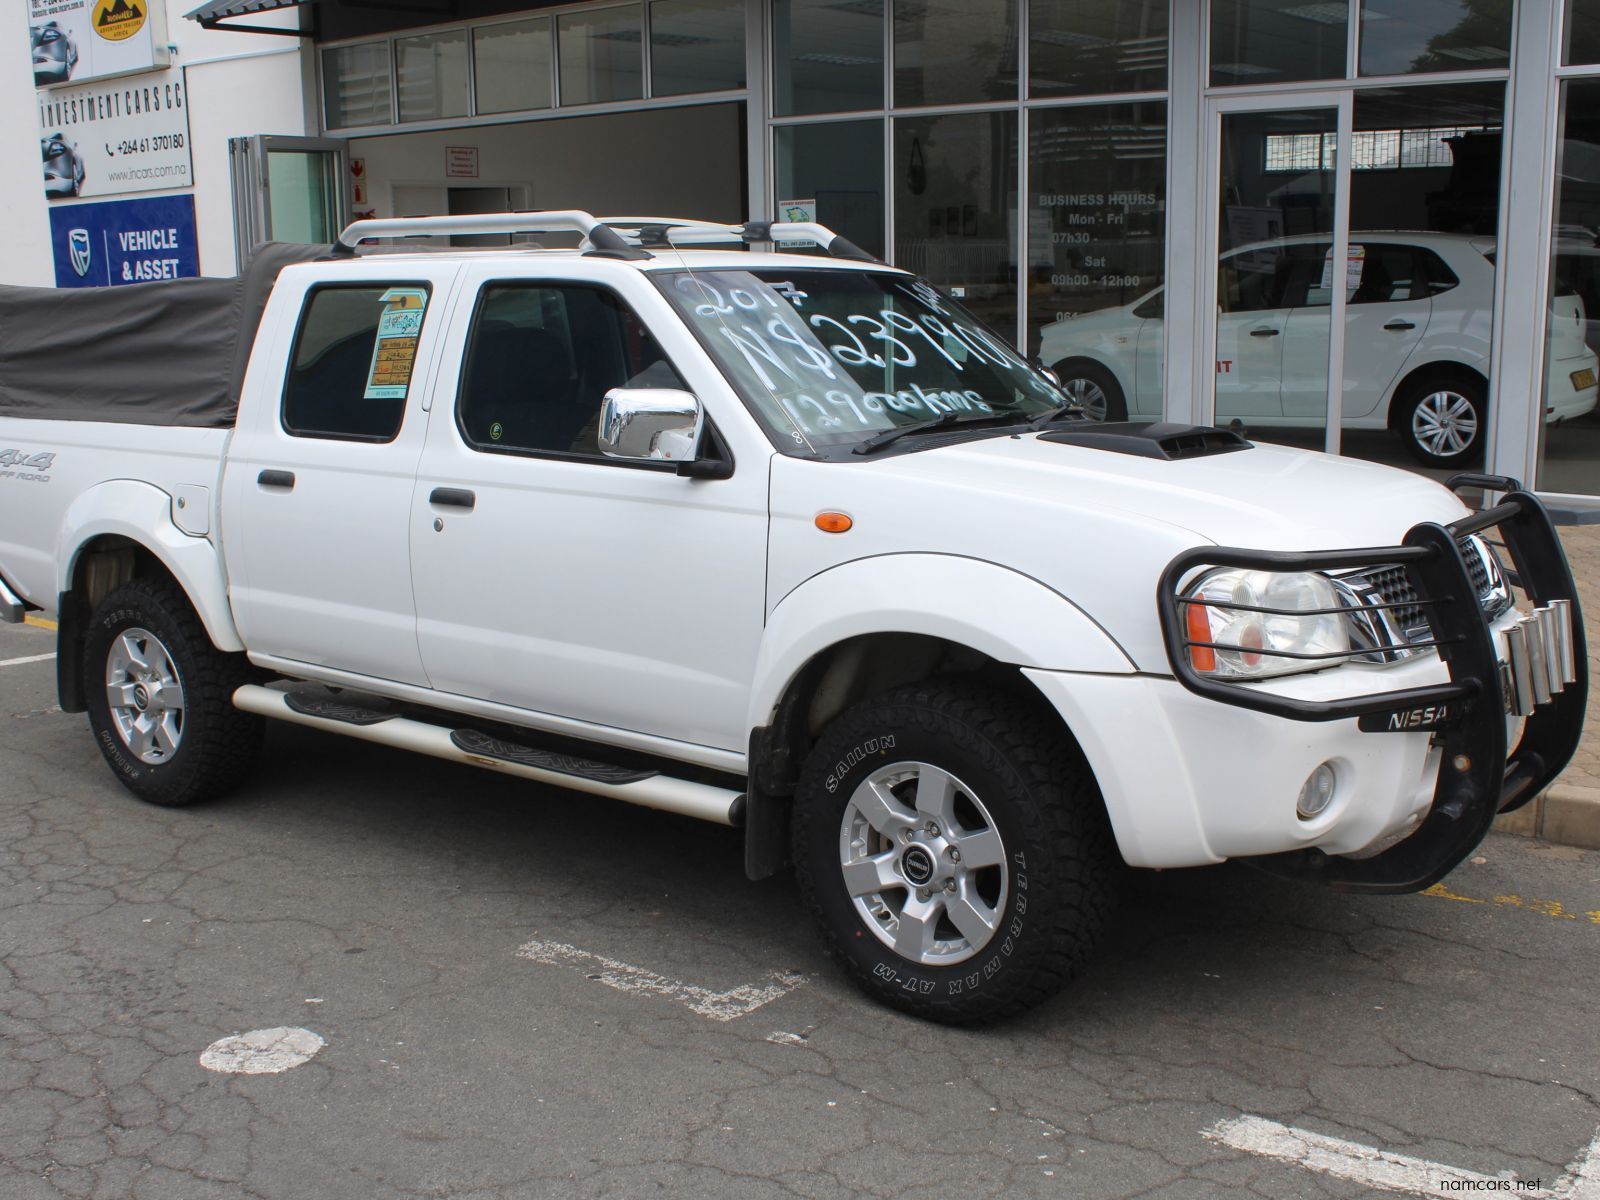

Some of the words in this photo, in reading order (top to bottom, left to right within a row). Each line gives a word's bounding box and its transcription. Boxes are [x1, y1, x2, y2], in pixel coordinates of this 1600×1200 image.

[41, 92, 120, 128] INVESTMENT
[125, 86, 160, 116] CARS
[117, 139, 138, 155] +264
[140, 138, 150, 153] 61
[153, 134, 184, 151] 370180
[108, 165, 187, 182] www.incars.com.na
[1039, 194, 1105, 206] BUSINESS
[1108, 193, 1157, 206] HOURS
[1069, 213, 1095, 224] Mon
[1107, 213, 1123, 224] Fri
[119, 229, 179, 252] VEHICLE
[1052, 233, 1090, 244] 07h30
[122, 262, 133, 280] &
[135, 259, 179, 280] ASSET
[1084, 256, 1106, 267] Sat
[1051, 274, 1089, 286] 09h00
[1102, 275, 1140, 287] 12h00
[674, 277, 808, 319] 2017
[16, 472, 51, 482] ROAD
[1388, 705, 1448, 731] NISSA
[825, 734, 896, 793] SAILUN
[873, 962, 936, 995] AT-M
